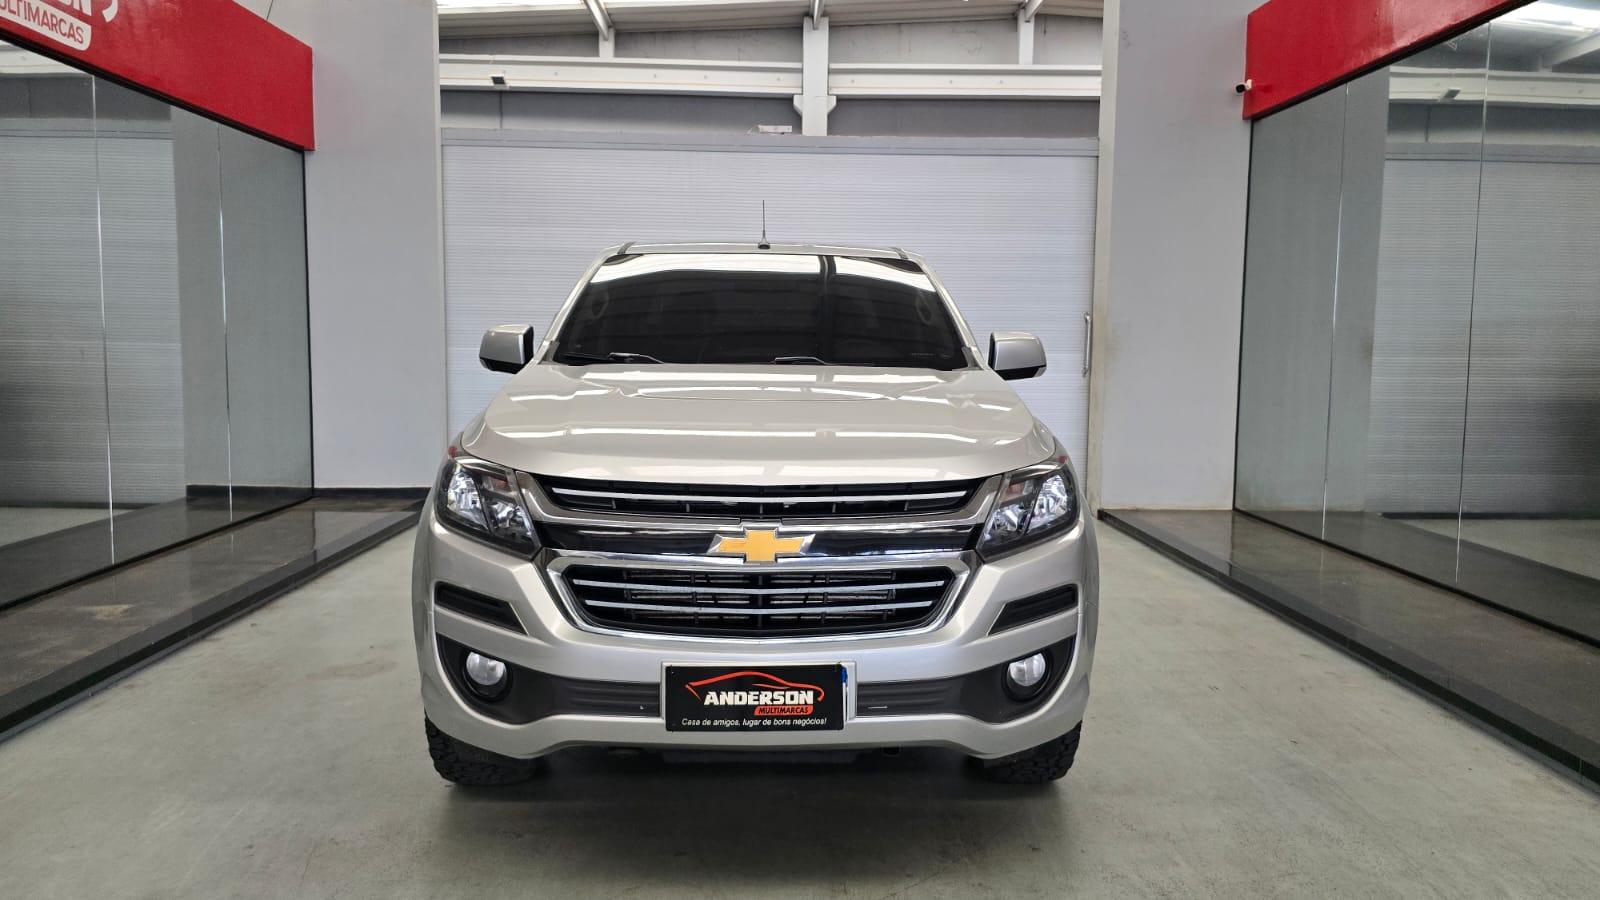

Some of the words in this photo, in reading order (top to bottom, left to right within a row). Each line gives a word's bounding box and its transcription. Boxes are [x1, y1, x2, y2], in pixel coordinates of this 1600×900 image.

[704, 690, 814, 705] ANDERSON
[758, 706, 809, 714] MULTIMARCAS
[681, 718, 700, 726] Casa
[702, 718, 711, 726] de
[713, 718, 740, 727] amigos,
[742, 718, 761, 728] lugar
[762, 718, 772, 726] de
[773, 718, 791, 726] bons
[793, 717, 827, 727] negócios!
